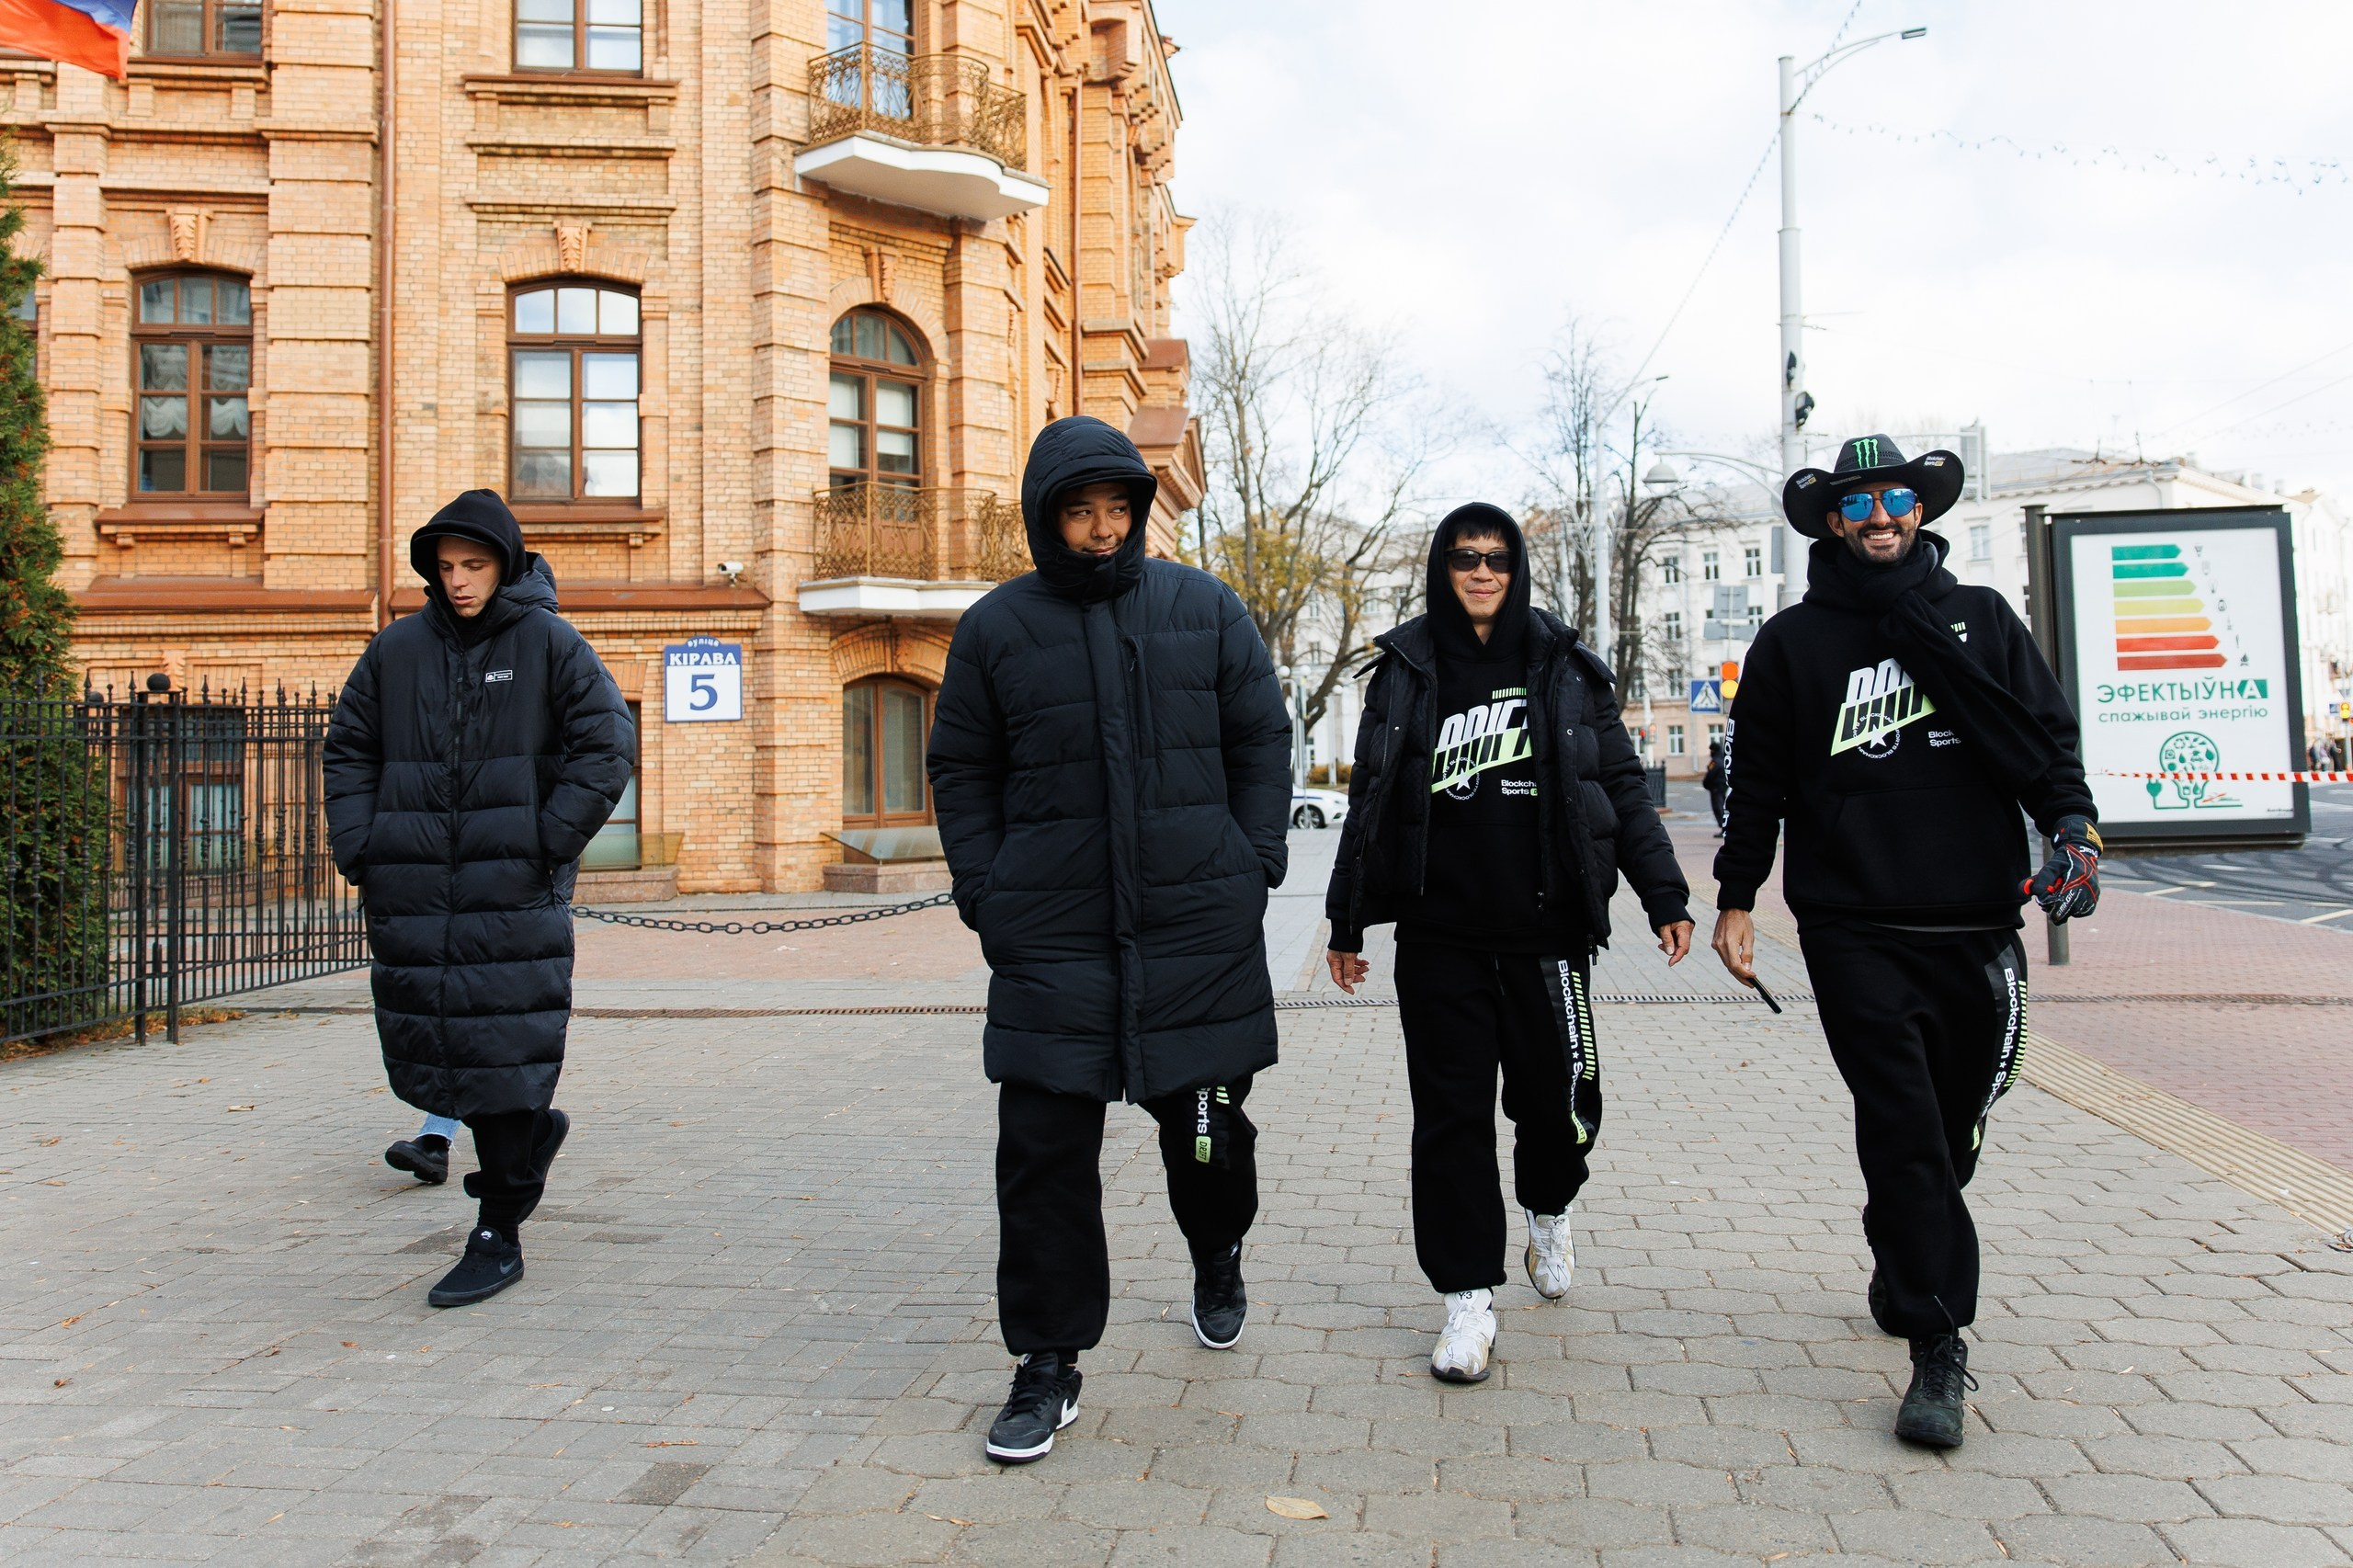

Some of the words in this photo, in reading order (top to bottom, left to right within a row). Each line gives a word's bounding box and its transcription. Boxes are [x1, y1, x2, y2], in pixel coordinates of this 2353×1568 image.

[669, 652, 737, 665] КІРАВА
[689, 674, 718, 711] 5
[2097, 676, 2268, 704] ЭФЕКТЫЎНА
[2098, 707, 2191, 722] спажывай
[2198, 705, 2268, 721] энергію
[1929, 737, 1961, 747] Sports
[1501, 787, 1529, 796] Sports
[1558, 960, 1578, 1049] Blockchain
[2001, 968, 2019, 1059] Blockchain
[1197, 1088, 1211, 1134] ports
[1199, 1141, 1208, 1161] DRIFT
